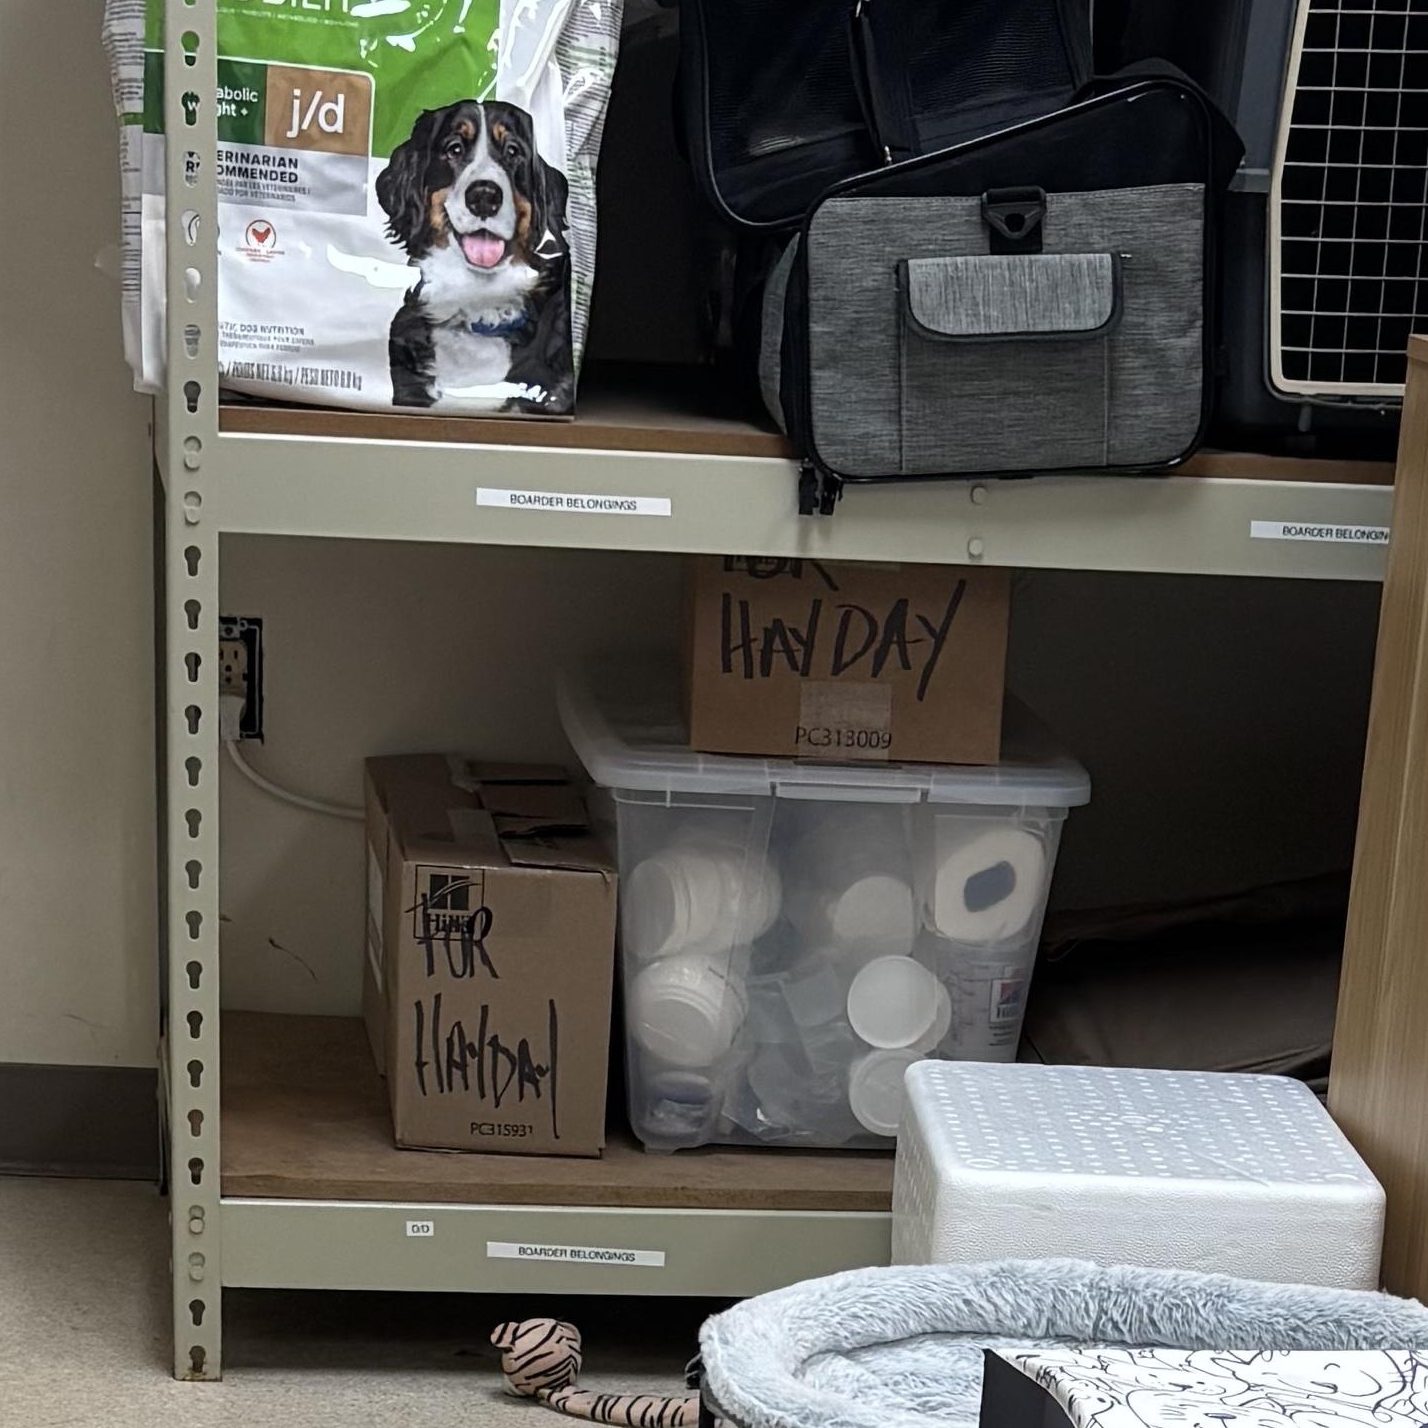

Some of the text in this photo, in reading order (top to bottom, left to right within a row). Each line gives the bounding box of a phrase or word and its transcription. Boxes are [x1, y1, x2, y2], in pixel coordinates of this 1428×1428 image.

[217, 85, 259, 103] abolic
[286, 88, 345, 138] j/d
[217, 150, 299, 169] ERINARIAN
[510, 494, 637, 511] BOARDER BELONGINGS
[1282, 525, 1389, 540] BOARDER BELONGIN
[795, 726, 893, 750] PC313009
[470, 1122, 533, 1138] PC315931
[518, 1246, 635, 1263] BOARDER BELONGINGS
